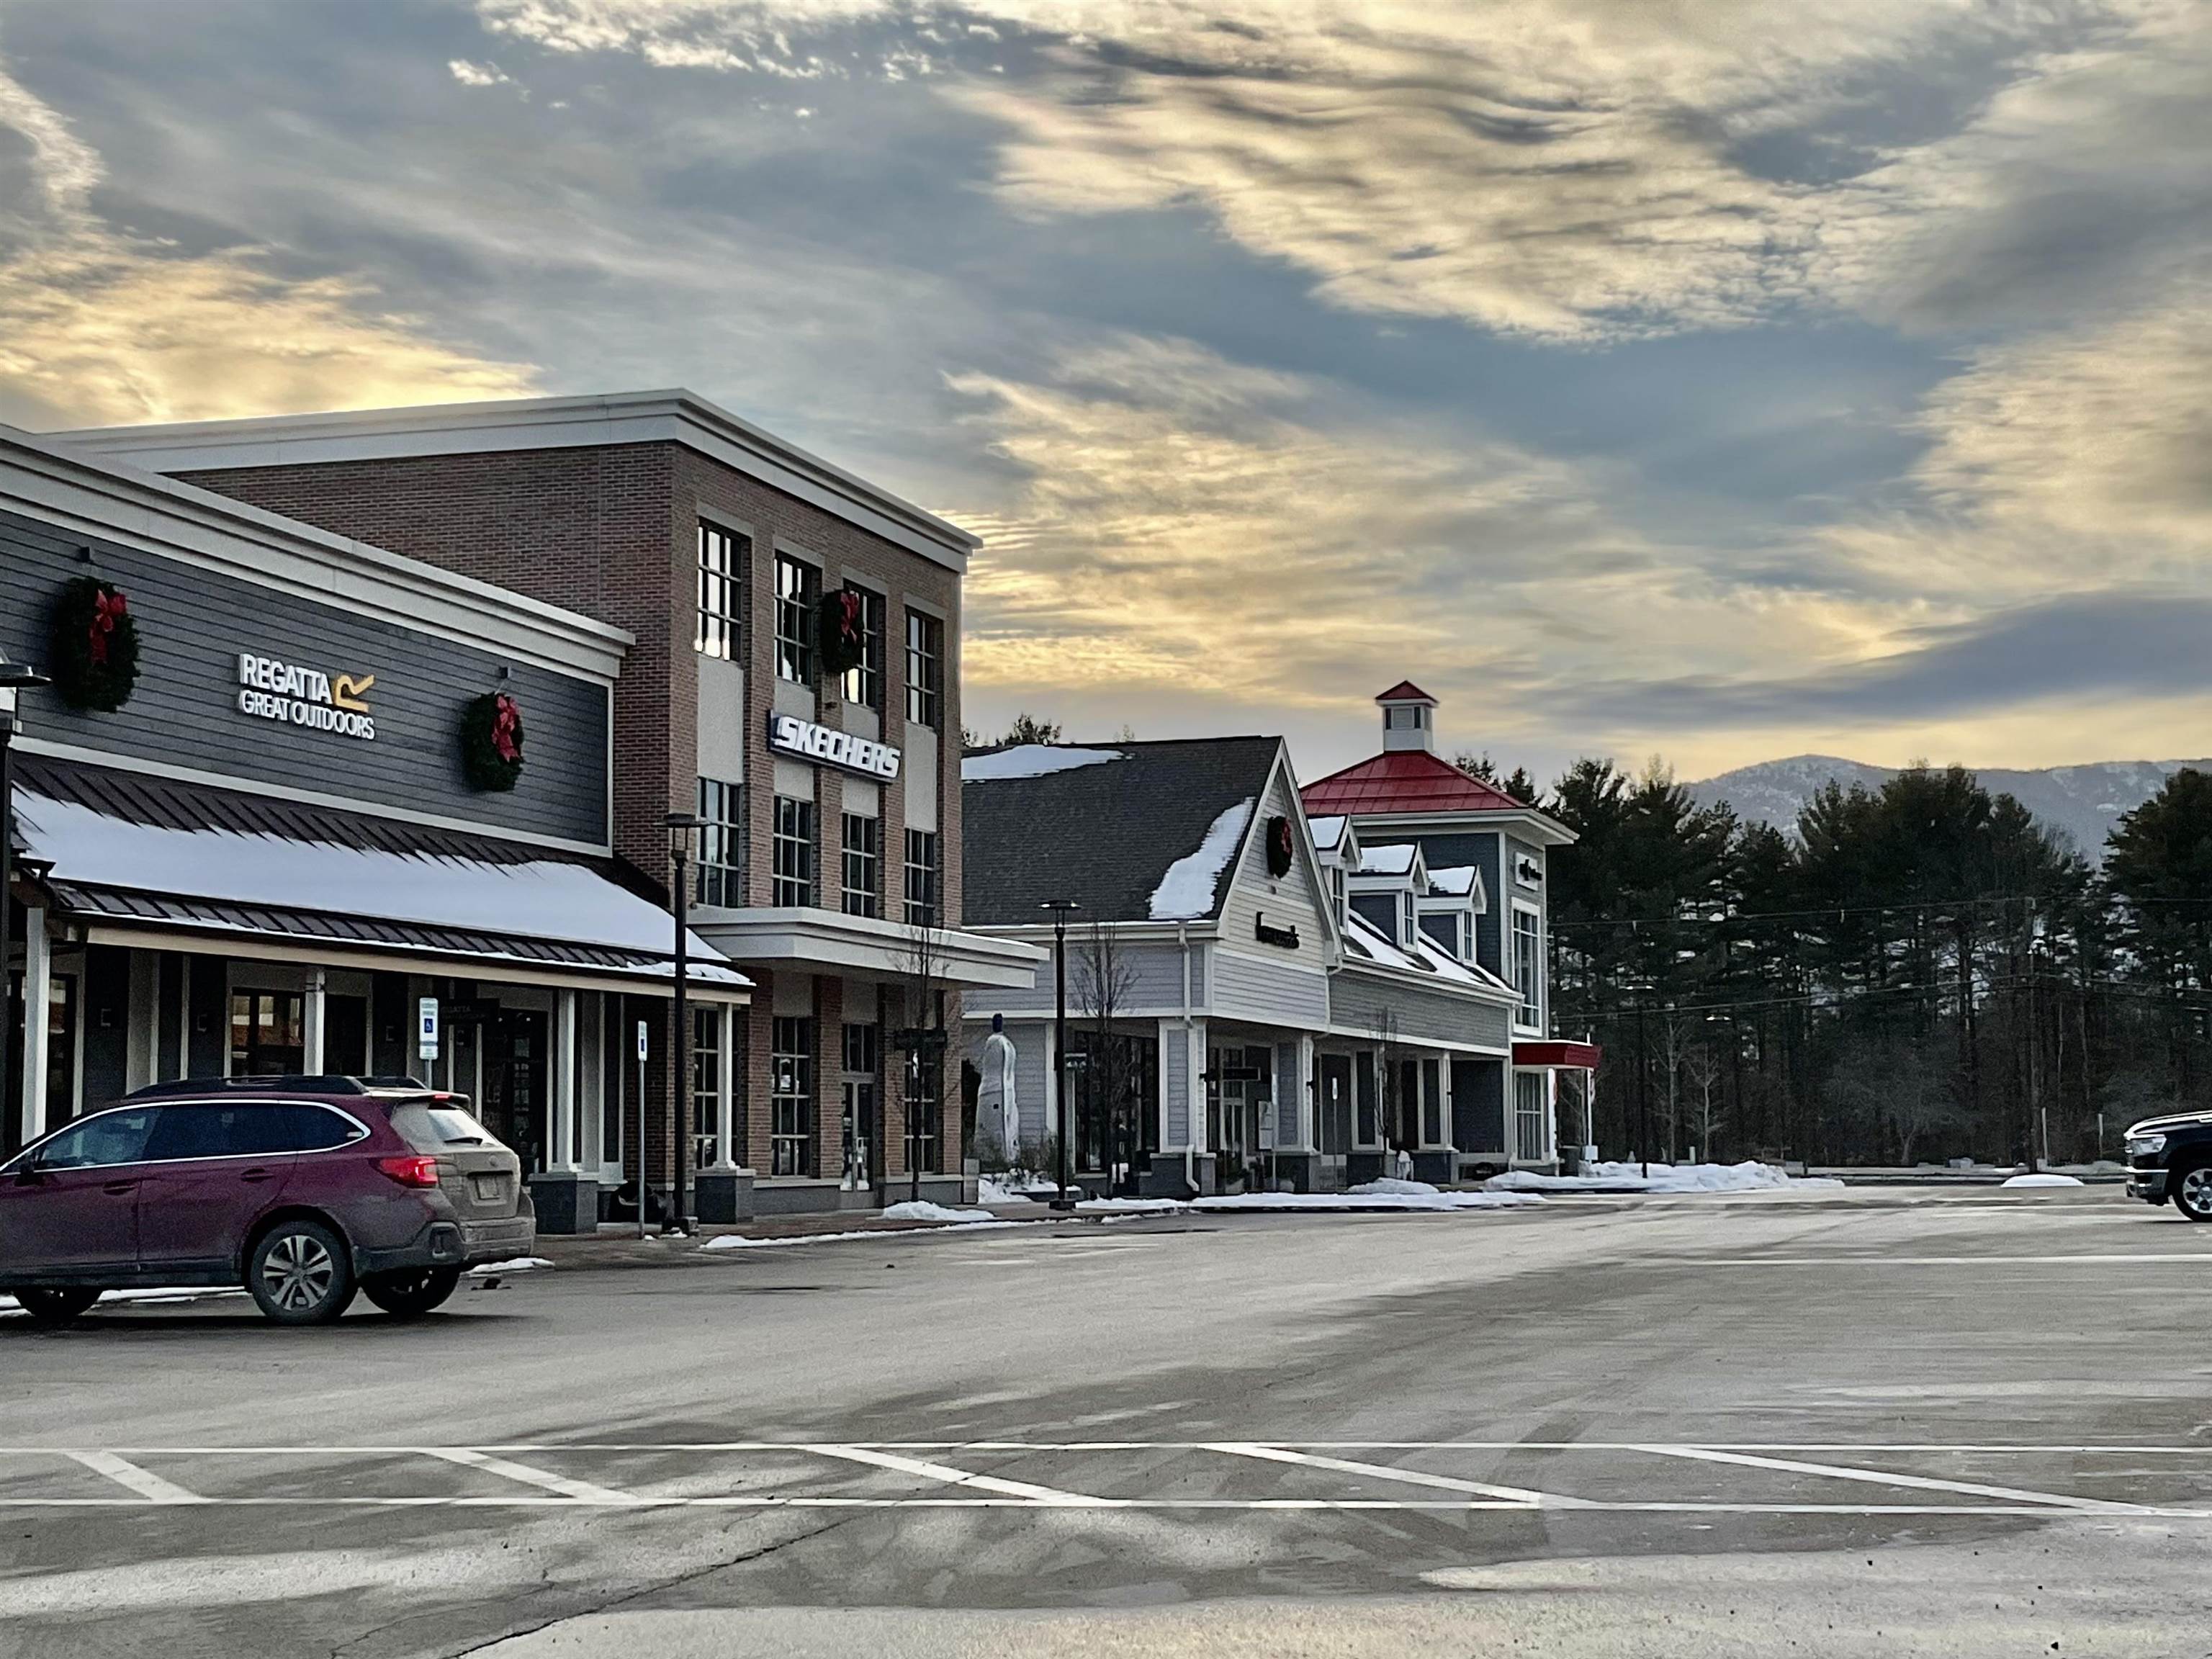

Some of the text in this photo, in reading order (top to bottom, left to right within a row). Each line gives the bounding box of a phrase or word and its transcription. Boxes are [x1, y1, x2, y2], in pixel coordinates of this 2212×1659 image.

[240, 654, 333, 704] REGATTA
[240, 689, 374, 740] GREAT OUTDOORS
[775, 716, 901, 778] SKECHERS
